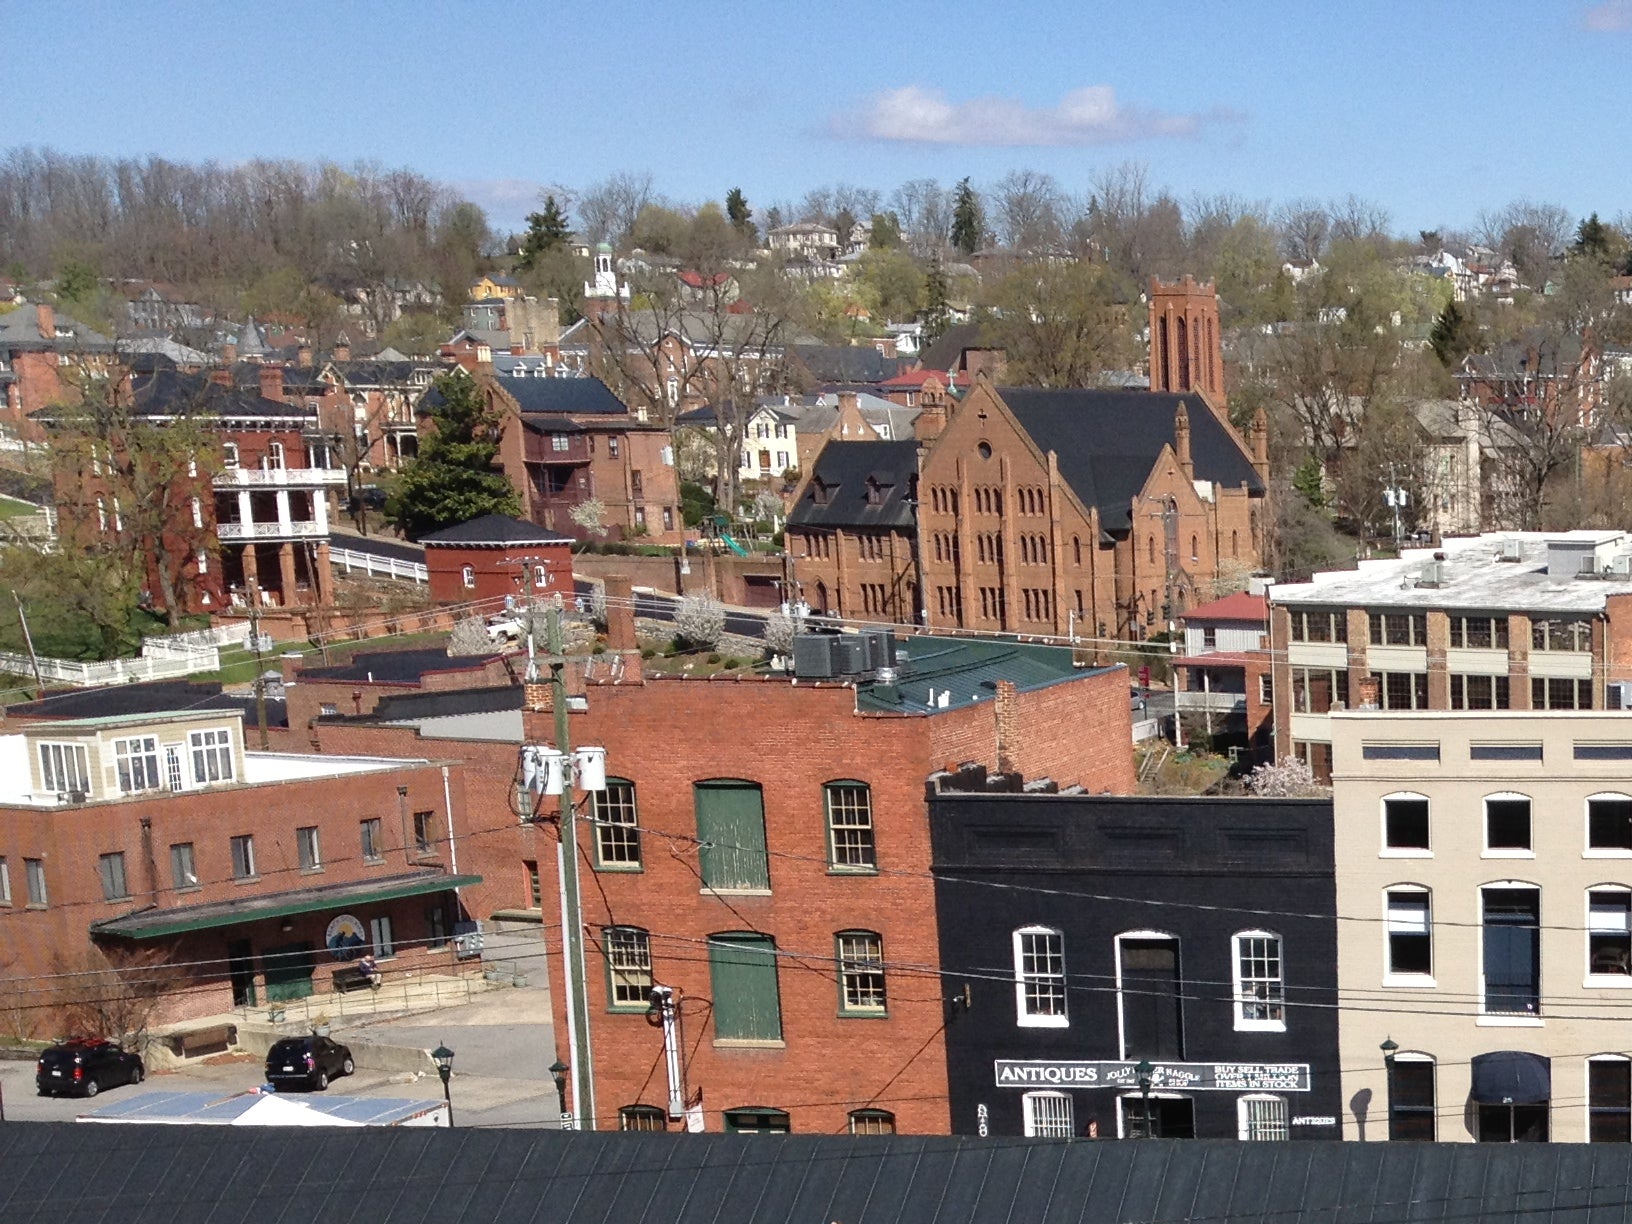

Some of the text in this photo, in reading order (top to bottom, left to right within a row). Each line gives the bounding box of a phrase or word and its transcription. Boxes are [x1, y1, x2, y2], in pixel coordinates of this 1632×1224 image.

[1000, 1066, 1098, 1082] ANTIQUES
[1106, 1066, 1132, 1080] JOLLY
[1214, 1065, 1299, 1074] BUY SELL TRADE
[1215, 1080, 1298, 1088] ITEMS IN STOCK
[1292, 1116, 1336, 1125] ANTIQUES
